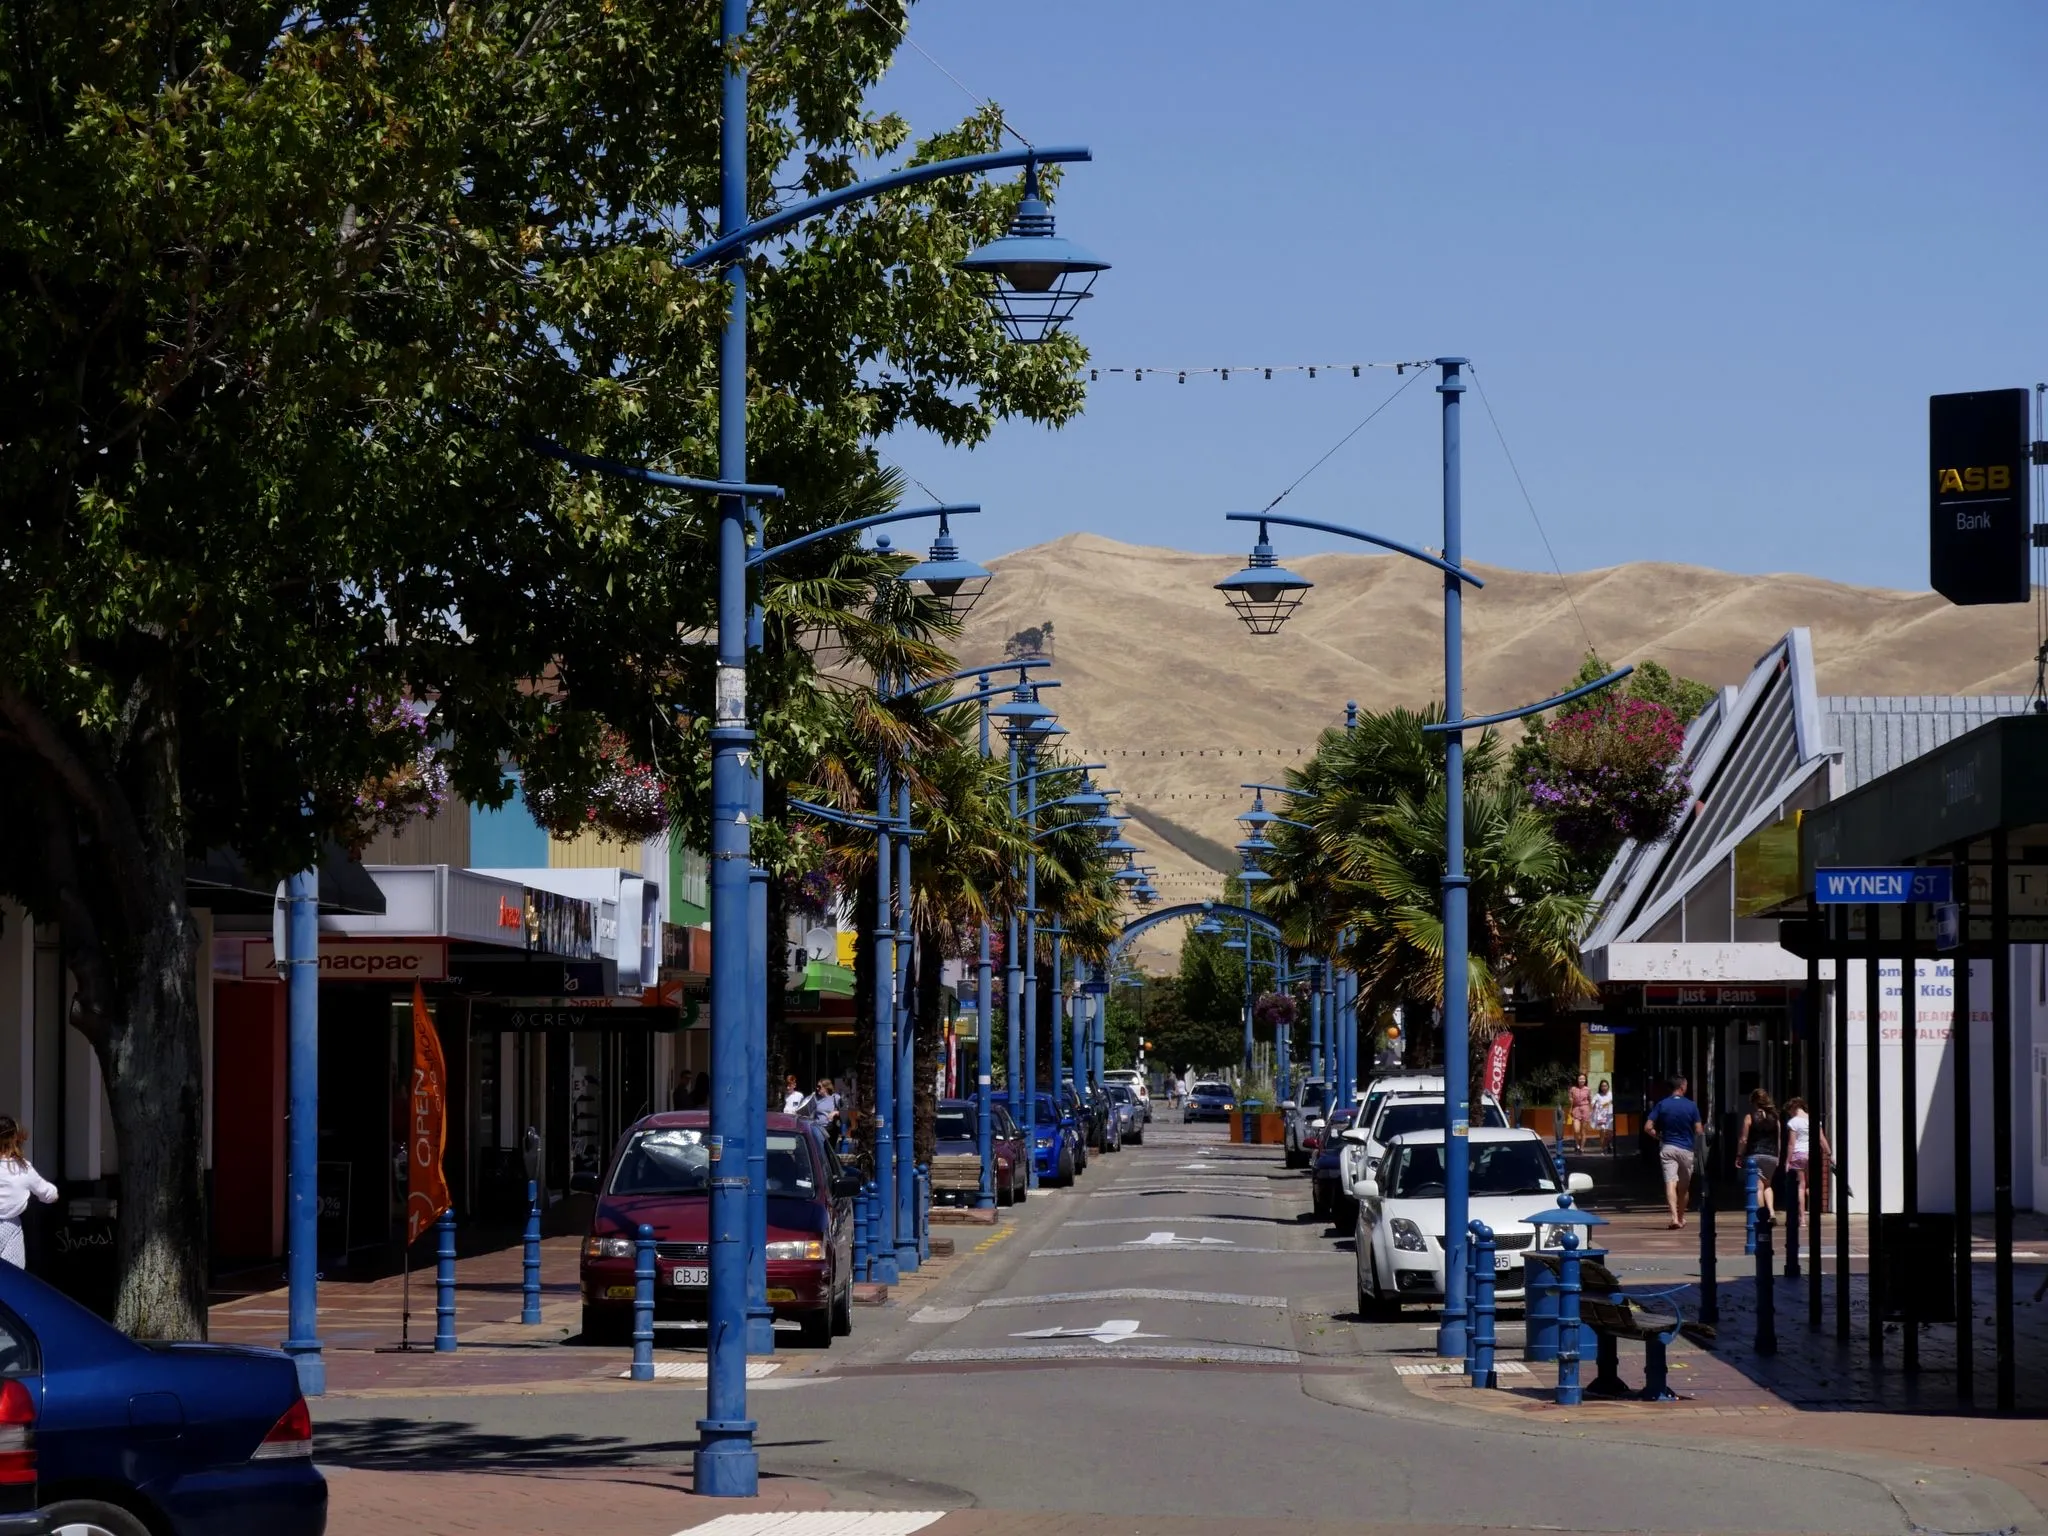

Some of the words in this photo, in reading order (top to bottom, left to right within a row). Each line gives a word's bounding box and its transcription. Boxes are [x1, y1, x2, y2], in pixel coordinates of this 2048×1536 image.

[1937, 465, 2011, 493] ASB
[1956, 511, 1991, 530] Bank
[1828, 875, 1903, 895] WYNEN
[1912, 875, 1938, 894] ST
[1676, 987, 1707, 1005] Just
[1716, 987, 1757, 1004] Jeans
[1920, 984, 1952, 996] Kids
[569, 998, 614, 1008] Spark
[529, 1012, 586, 1026] CREW
[414, 1067, 432, 1169] OPEN
[55, 1225, 114, 1253] Shoes!
